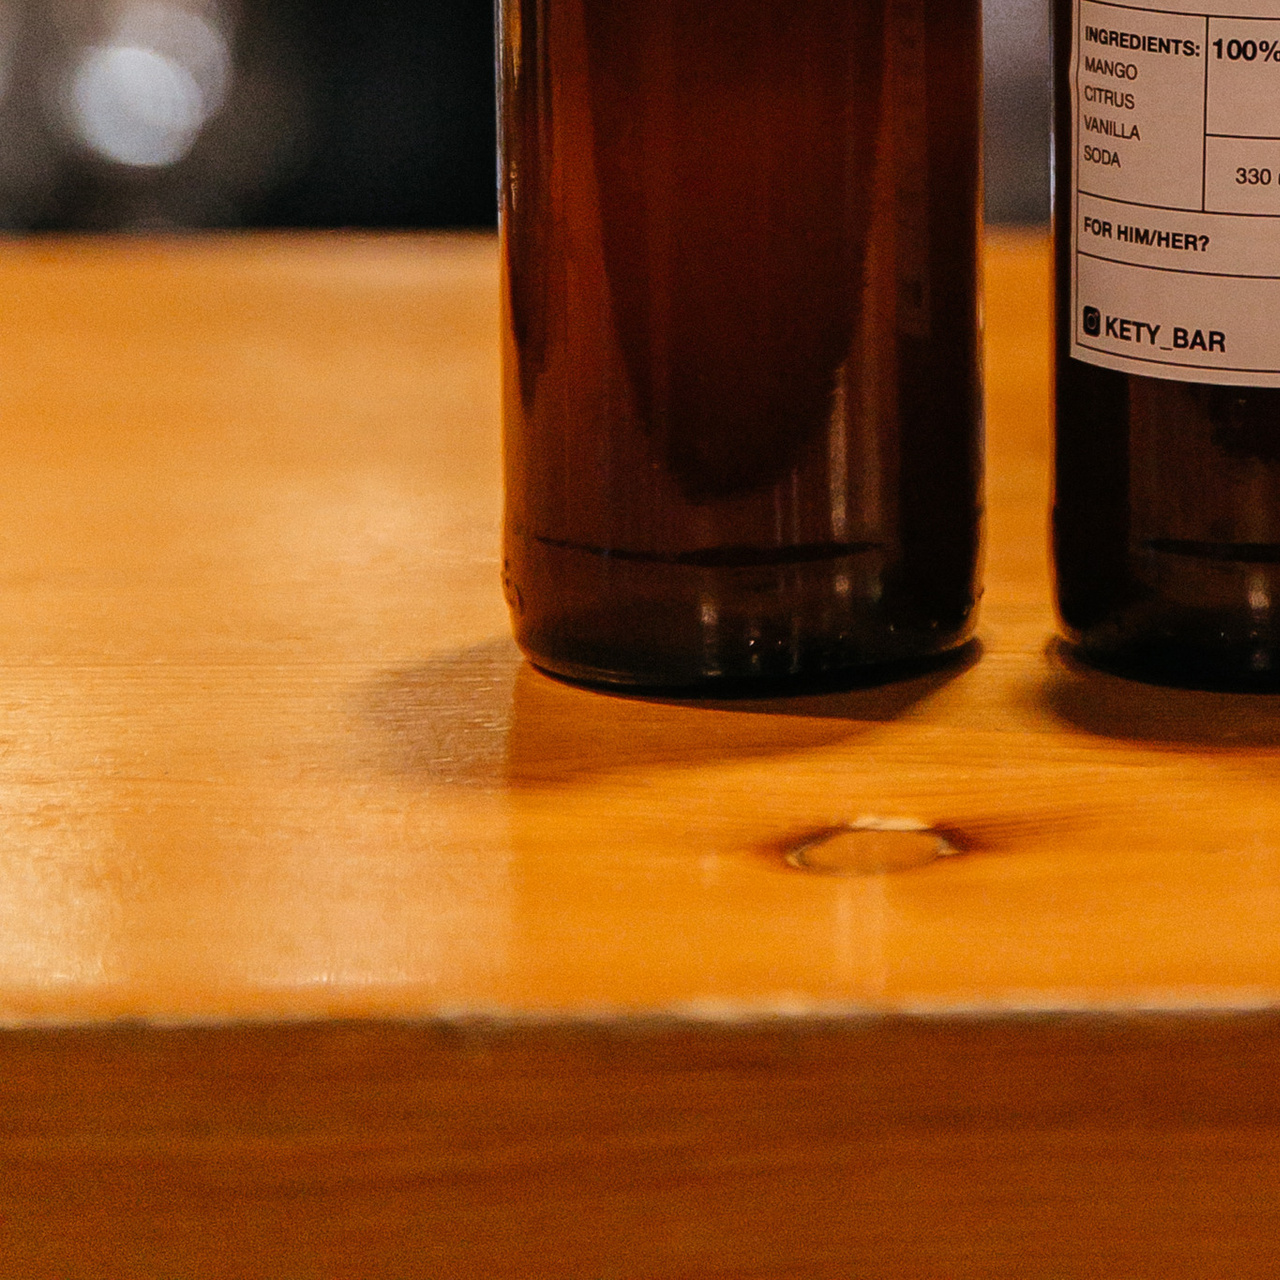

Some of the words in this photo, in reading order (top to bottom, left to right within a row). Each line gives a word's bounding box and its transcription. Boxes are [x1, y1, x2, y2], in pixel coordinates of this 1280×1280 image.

[1085, 26, 1200, 57] INGREDIENTS:
[1085, 56, 1138, 81] MANGO
[1084, 85, 1135, 110] CITRUS
[1084, 115, 1141, 141] VANILLA
[1084, 145, 1121, 168] SODA
[1235, 167, 1272, 186] 330
[1084, 216, 1113, 240] FOR
[1117, 223, 1210, 252] HIM/HER?
[1105, 315, 1226, 353] KETY_BAR
